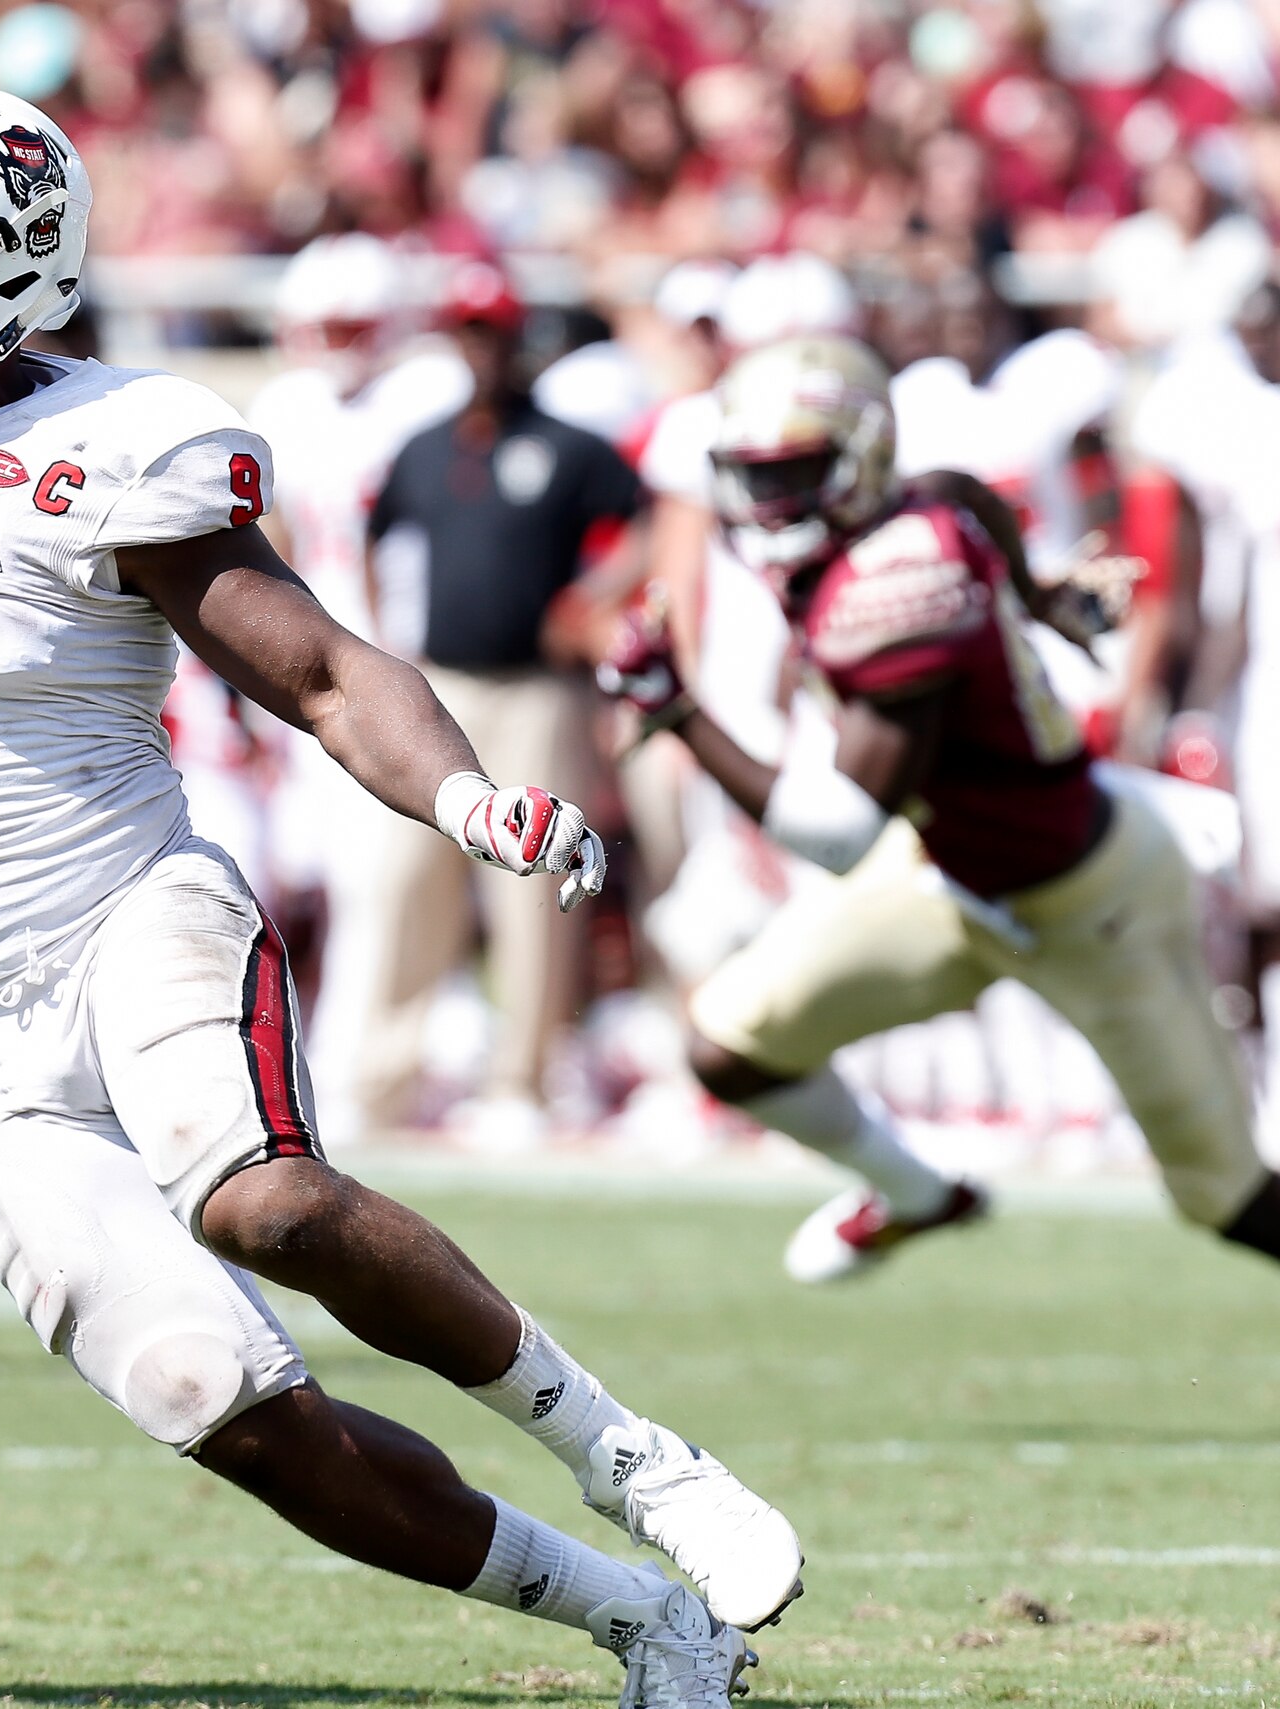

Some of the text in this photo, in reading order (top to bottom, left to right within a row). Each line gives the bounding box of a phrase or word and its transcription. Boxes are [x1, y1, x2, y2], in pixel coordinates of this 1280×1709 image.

[13, 146, 45, 160] NC STATE
[32, 460, 86, 516] C
[228, 453, 264, 527] 9
[531, 1380, 565, 1420] adidas
[612, 1451, 647, 1487] adidas
[610, 1620, 645, 1647] adidas
